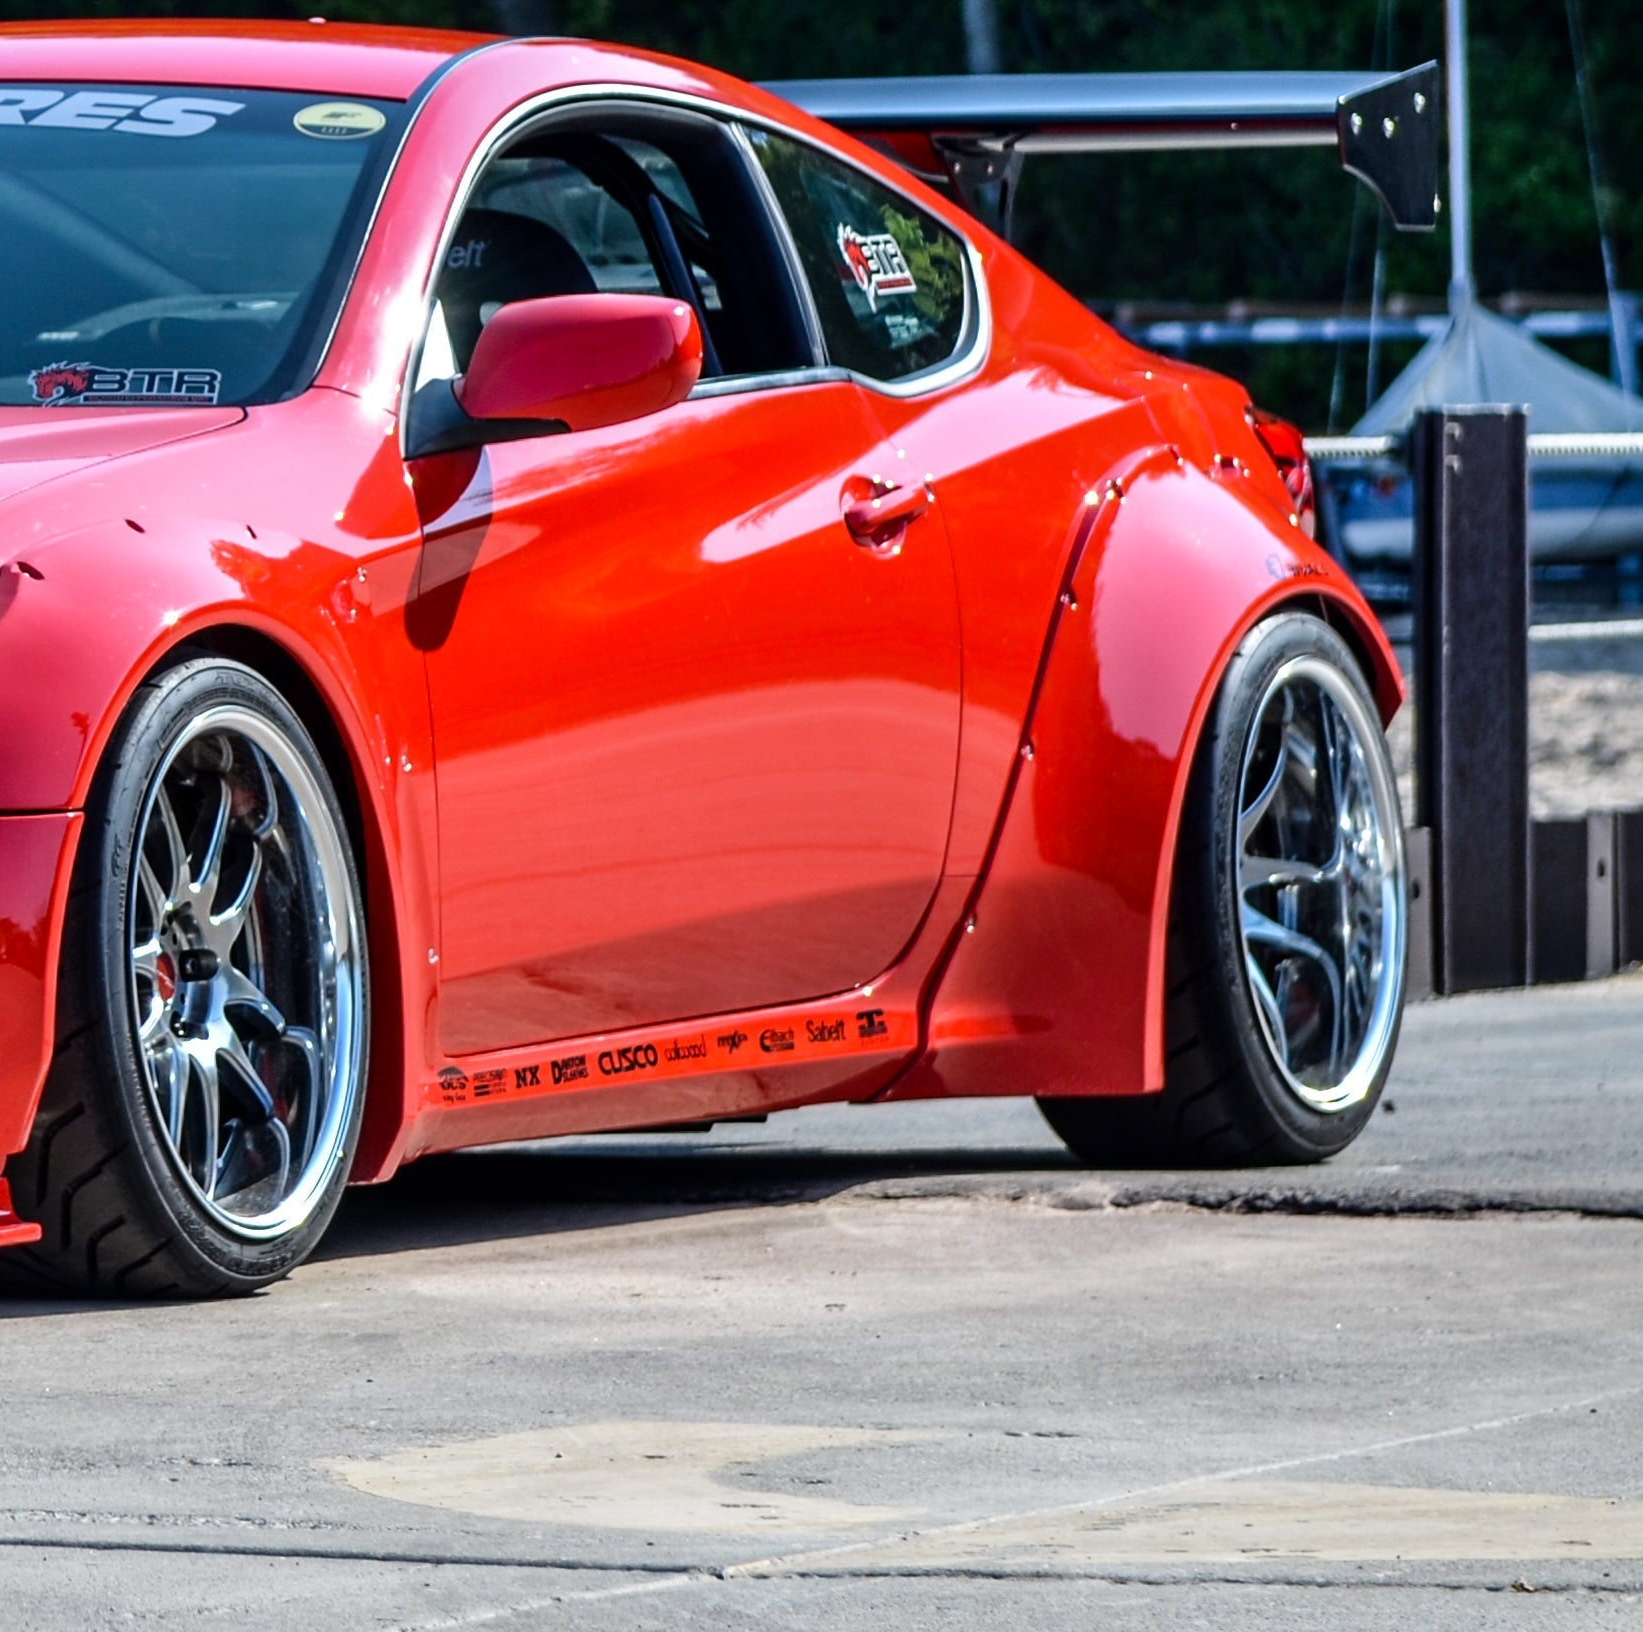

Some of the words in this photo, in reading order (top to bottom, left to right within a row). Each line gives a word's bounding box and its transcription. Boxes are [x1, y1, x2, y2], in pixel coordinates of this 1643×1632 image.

[448, 239, 486, 268] elt
[88, 368, 221, 395] BTR
[598, 1043, 658, 1076] CUSCO
[514, 1064, 540, 1089] NX
